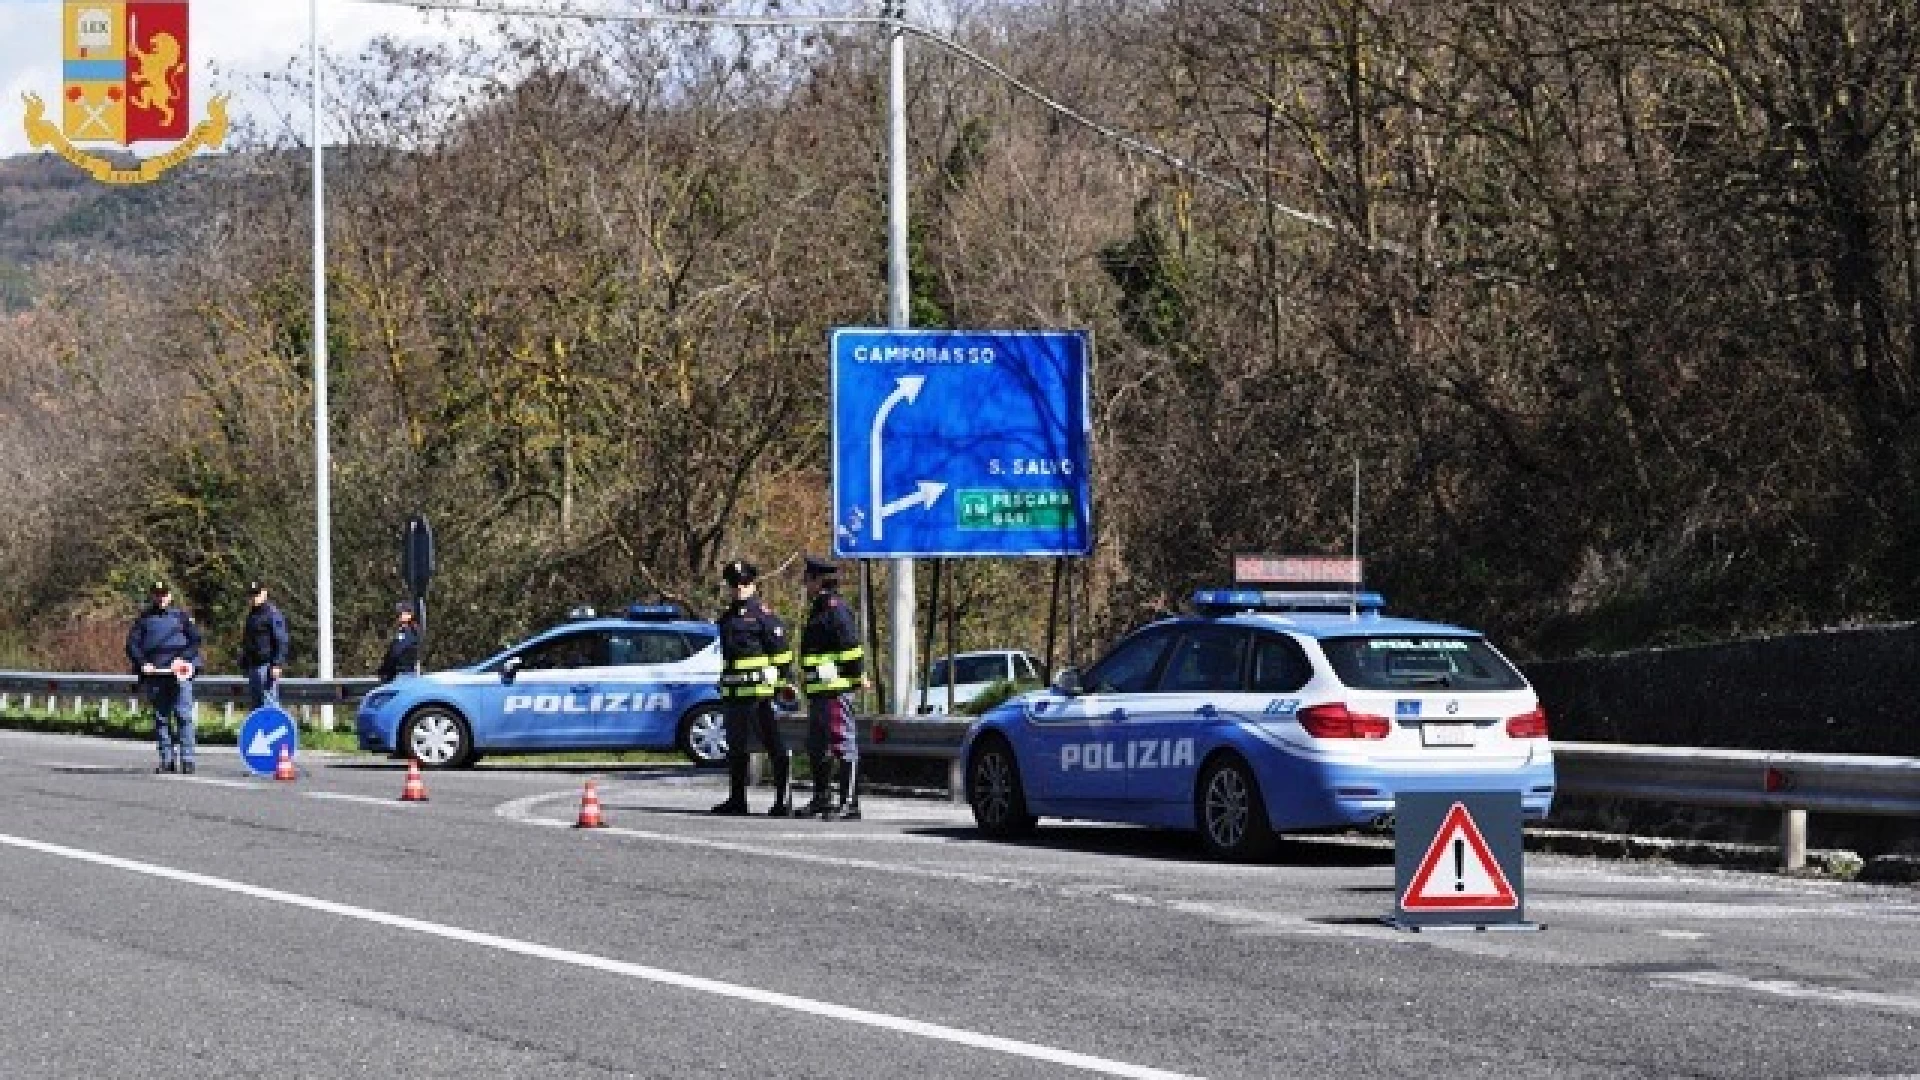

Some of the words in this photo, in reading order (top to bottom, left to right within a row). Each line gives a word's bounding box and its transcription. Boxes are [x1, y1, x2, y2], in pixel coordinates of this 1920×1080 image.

[854, 346, 996, 363] CAMPOBASSO
[989, 458, 1006, 474] S.
[503, 692, 672, 715] POLIZIA
[1061, 737, 1195, 771] POLIZIA
